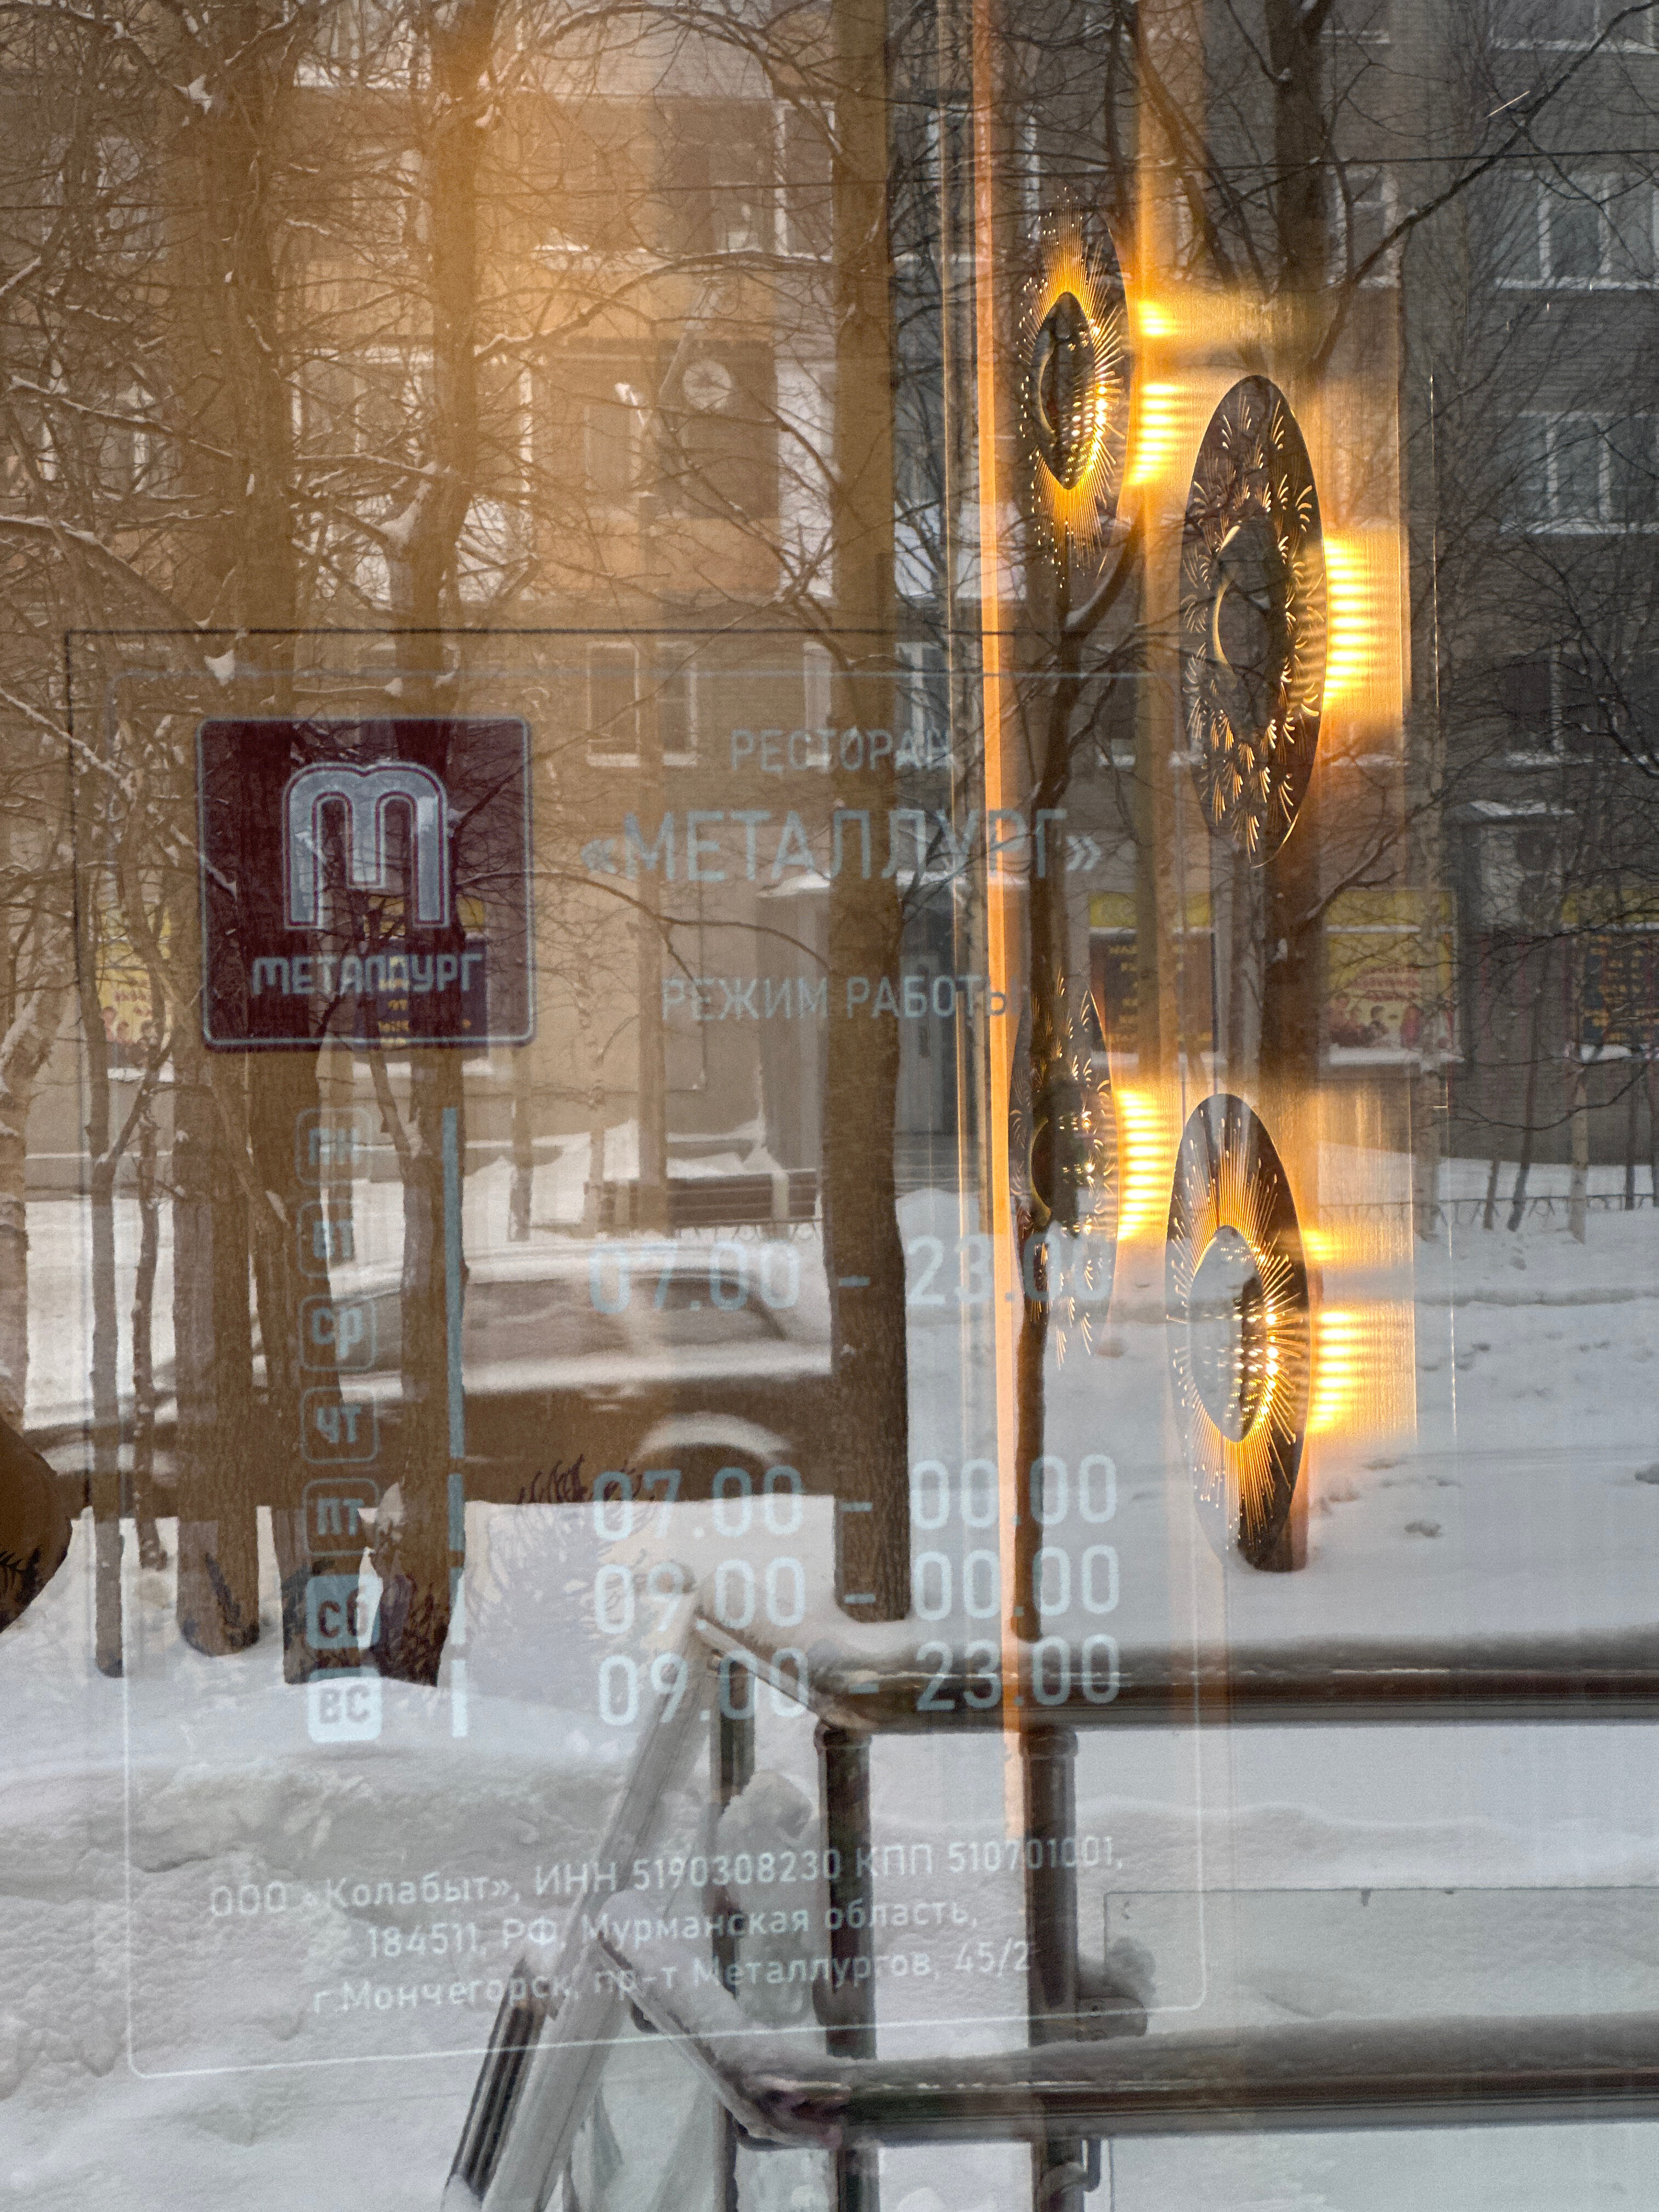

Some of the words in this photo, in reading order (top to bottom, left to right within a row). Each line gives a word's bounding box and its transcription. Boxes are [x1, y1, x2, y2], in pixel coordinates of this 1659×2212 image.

[730, 725, 952, 772] РЕСТОРАН
[579, 808, 1102, 882] «МЕТАЛЛУРГ»
[662, 975, 828, 1022] РЕЖИМ
[589, 1238, 801, 1314] 07.00
[906, 1231, 1114, 1306] 23.00
[592, 1464, 804, 1542] 07.00
[909, 1453, 1118, 1530] 00.00
[594, 1555, 806, 1635] 09.00
[912, 1544, 1120, 1622] 00.00
[599, 1646, 809, 1726] 09.00
[915, 1633, 1120, 1712] 23.00
[211, 1880, 287, 1918] ООО
[534, 1860, 618, 1897] ИНН
[632, 1848, 842, 1892] 5190308230
[855, 1842, 933, 1878] КПП
[501, 1917, 566, 1950] РФ,
[581, 1909, 809, 1951] Мурманская
[824, 1898, 979, 1931] область,
[953, 1938, 1031, 1978] 45/2
